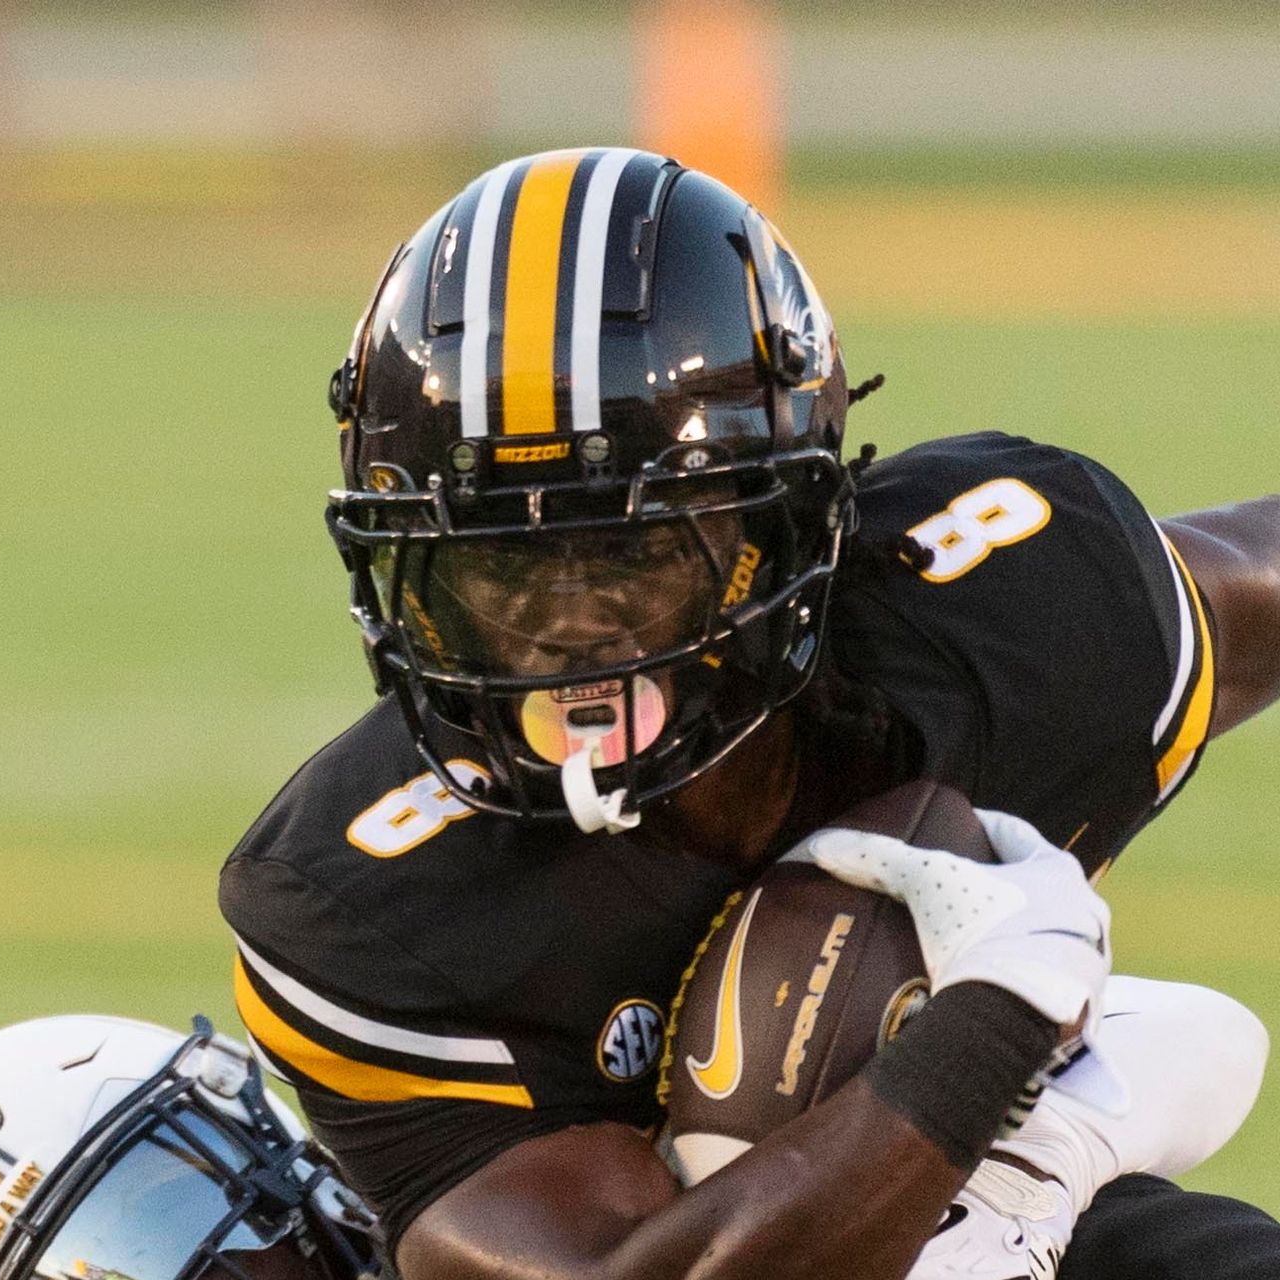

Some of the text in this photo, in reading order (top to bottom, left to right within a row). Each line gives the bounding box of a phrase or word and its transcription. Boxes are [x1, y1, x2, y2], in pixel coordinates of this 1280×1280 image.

[495, 442, 570, 463] MIZZOU
[898, 476, 1053, 584] 8
[345, 758, 493, 859] 8
[602, 1005, 659, 1077] SEC
[7, 1161, 46, 1200] WAY
[0, 1201, 18, 1216] A
